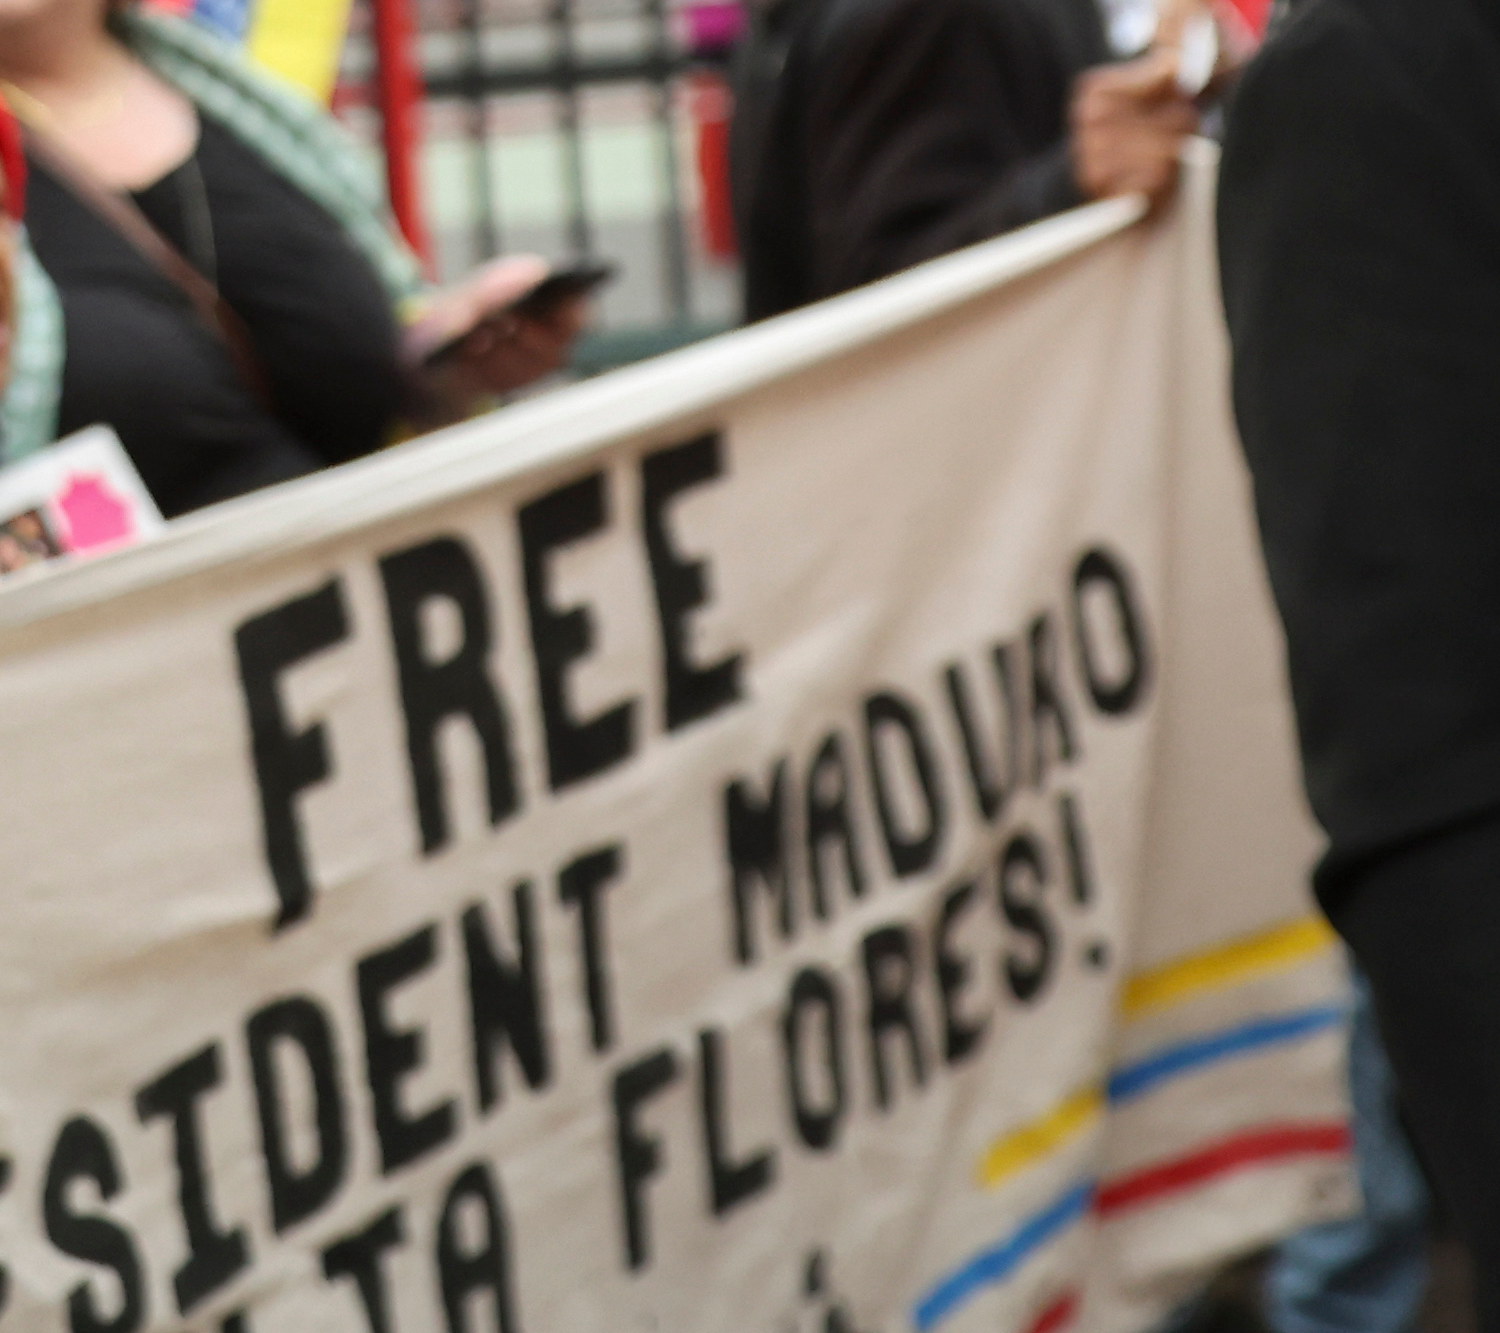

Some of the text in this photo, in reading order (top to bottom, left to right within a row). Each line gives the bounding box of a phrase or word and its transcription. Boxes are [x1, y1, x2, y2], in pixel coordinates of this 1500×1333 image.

[235, 429, 746, 931] FREE
[722, 544, 1154, 966] MADURO
[610, 791, 1111, 1273] FLORES!
